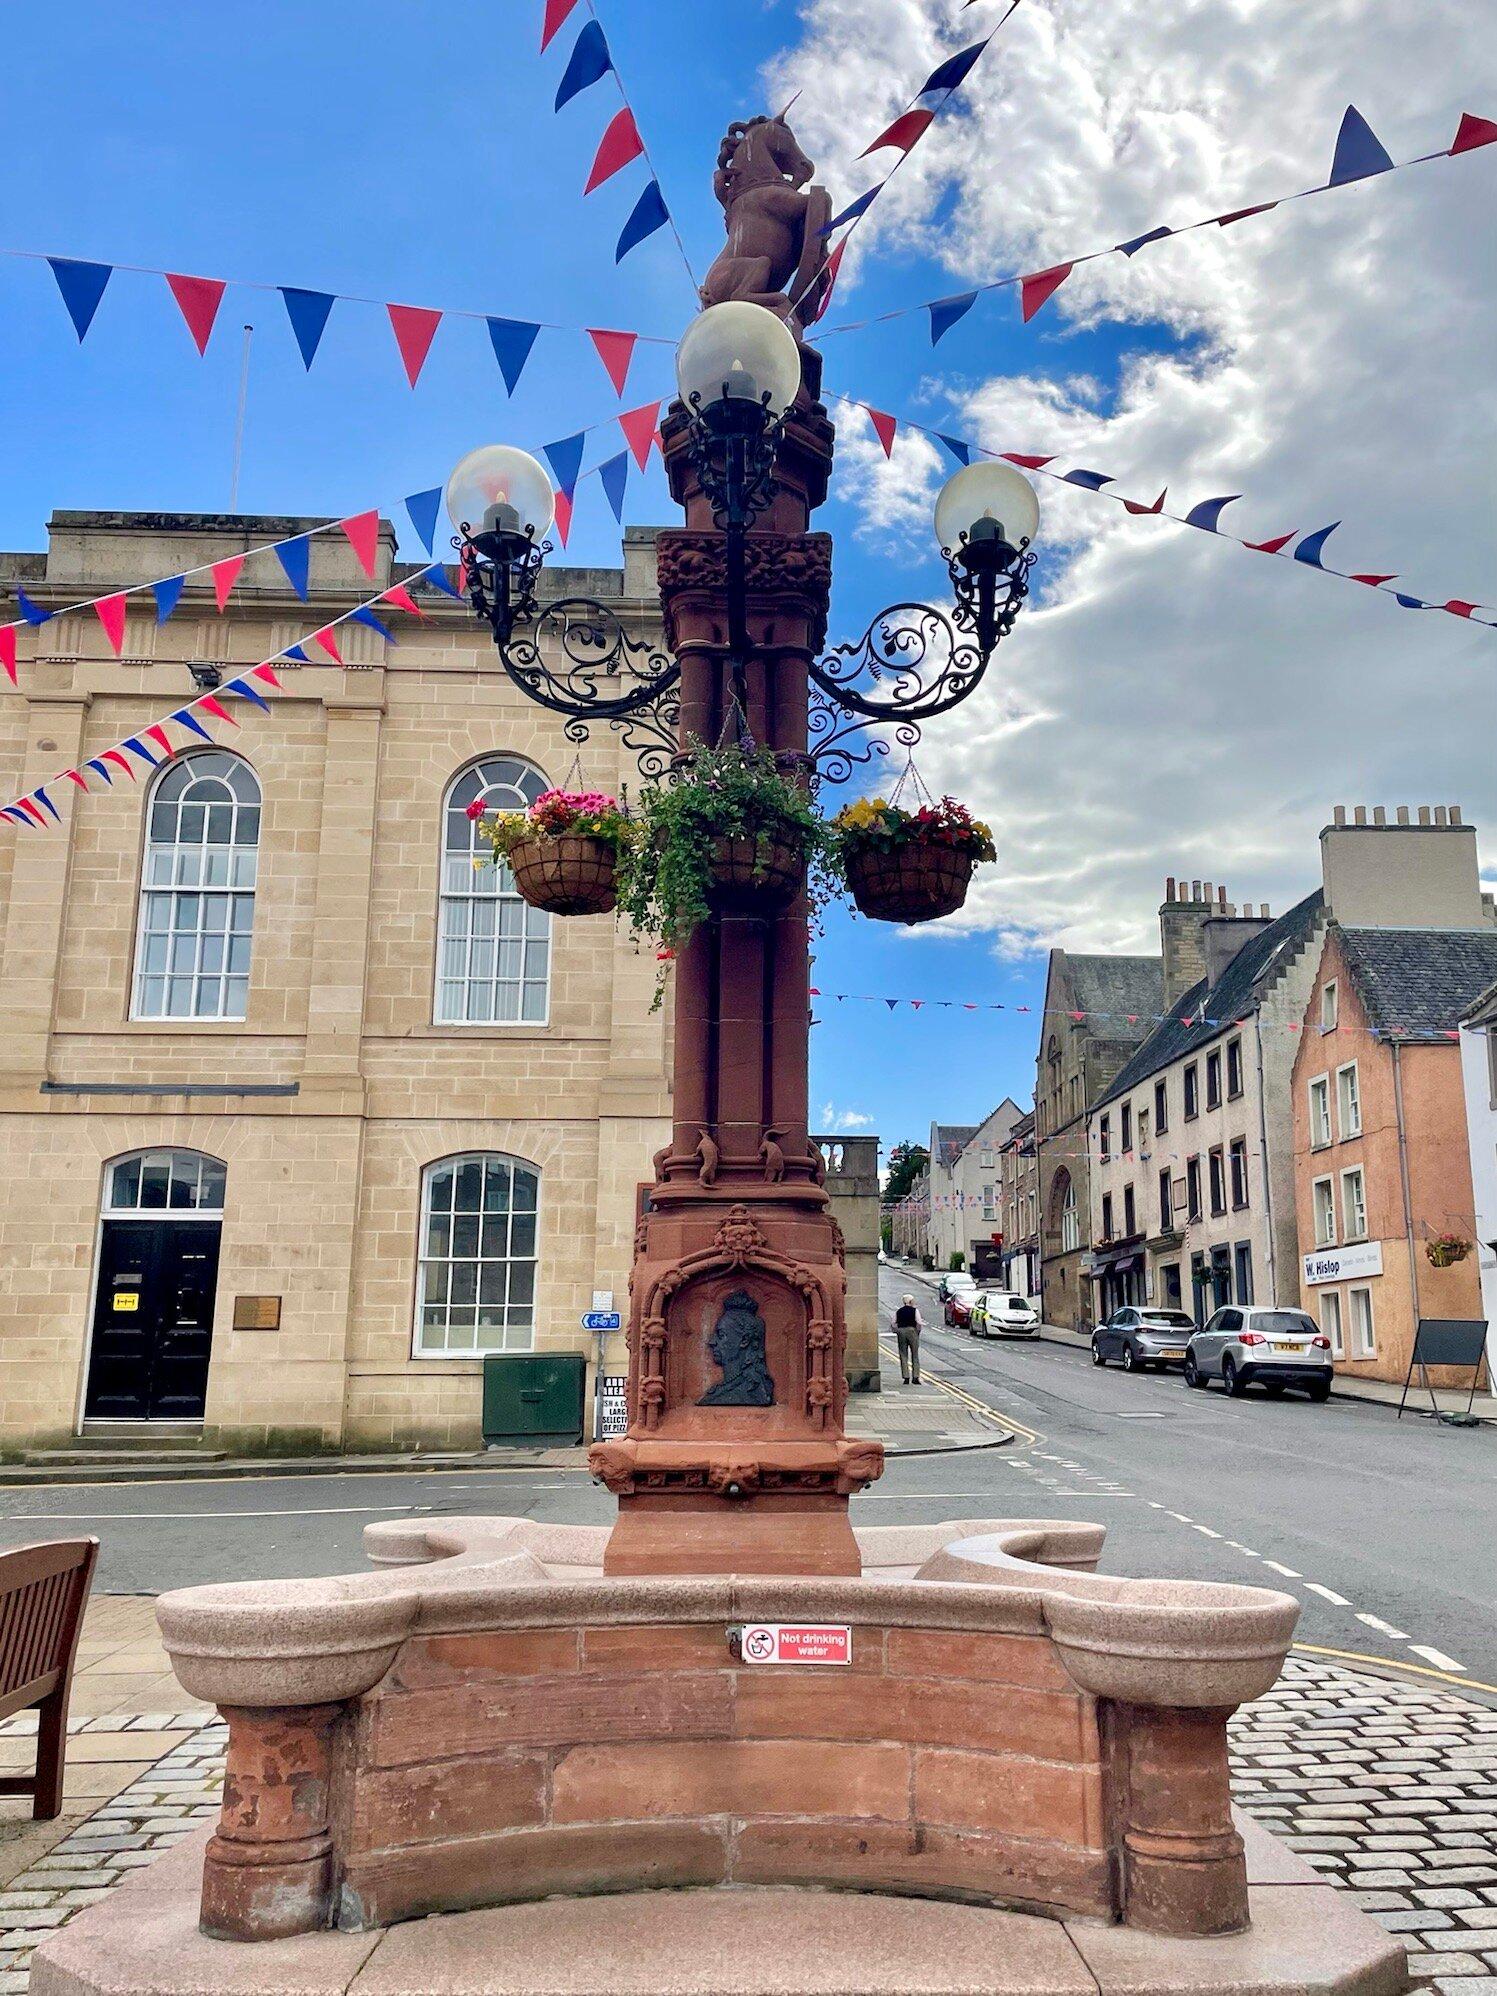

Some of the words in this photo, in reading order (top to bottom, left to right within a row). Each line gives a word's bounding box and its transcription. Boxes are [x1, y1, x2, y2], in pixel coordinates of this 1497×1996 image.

[1305, 1262, 1315, 1277] W.
[1316, 1260, 1340, 1276] Hislop
[781, 1633, 800, 1644] Not
[802, 1633, 845, 1646] drinking
[797, 1646, 829, 1656] water
